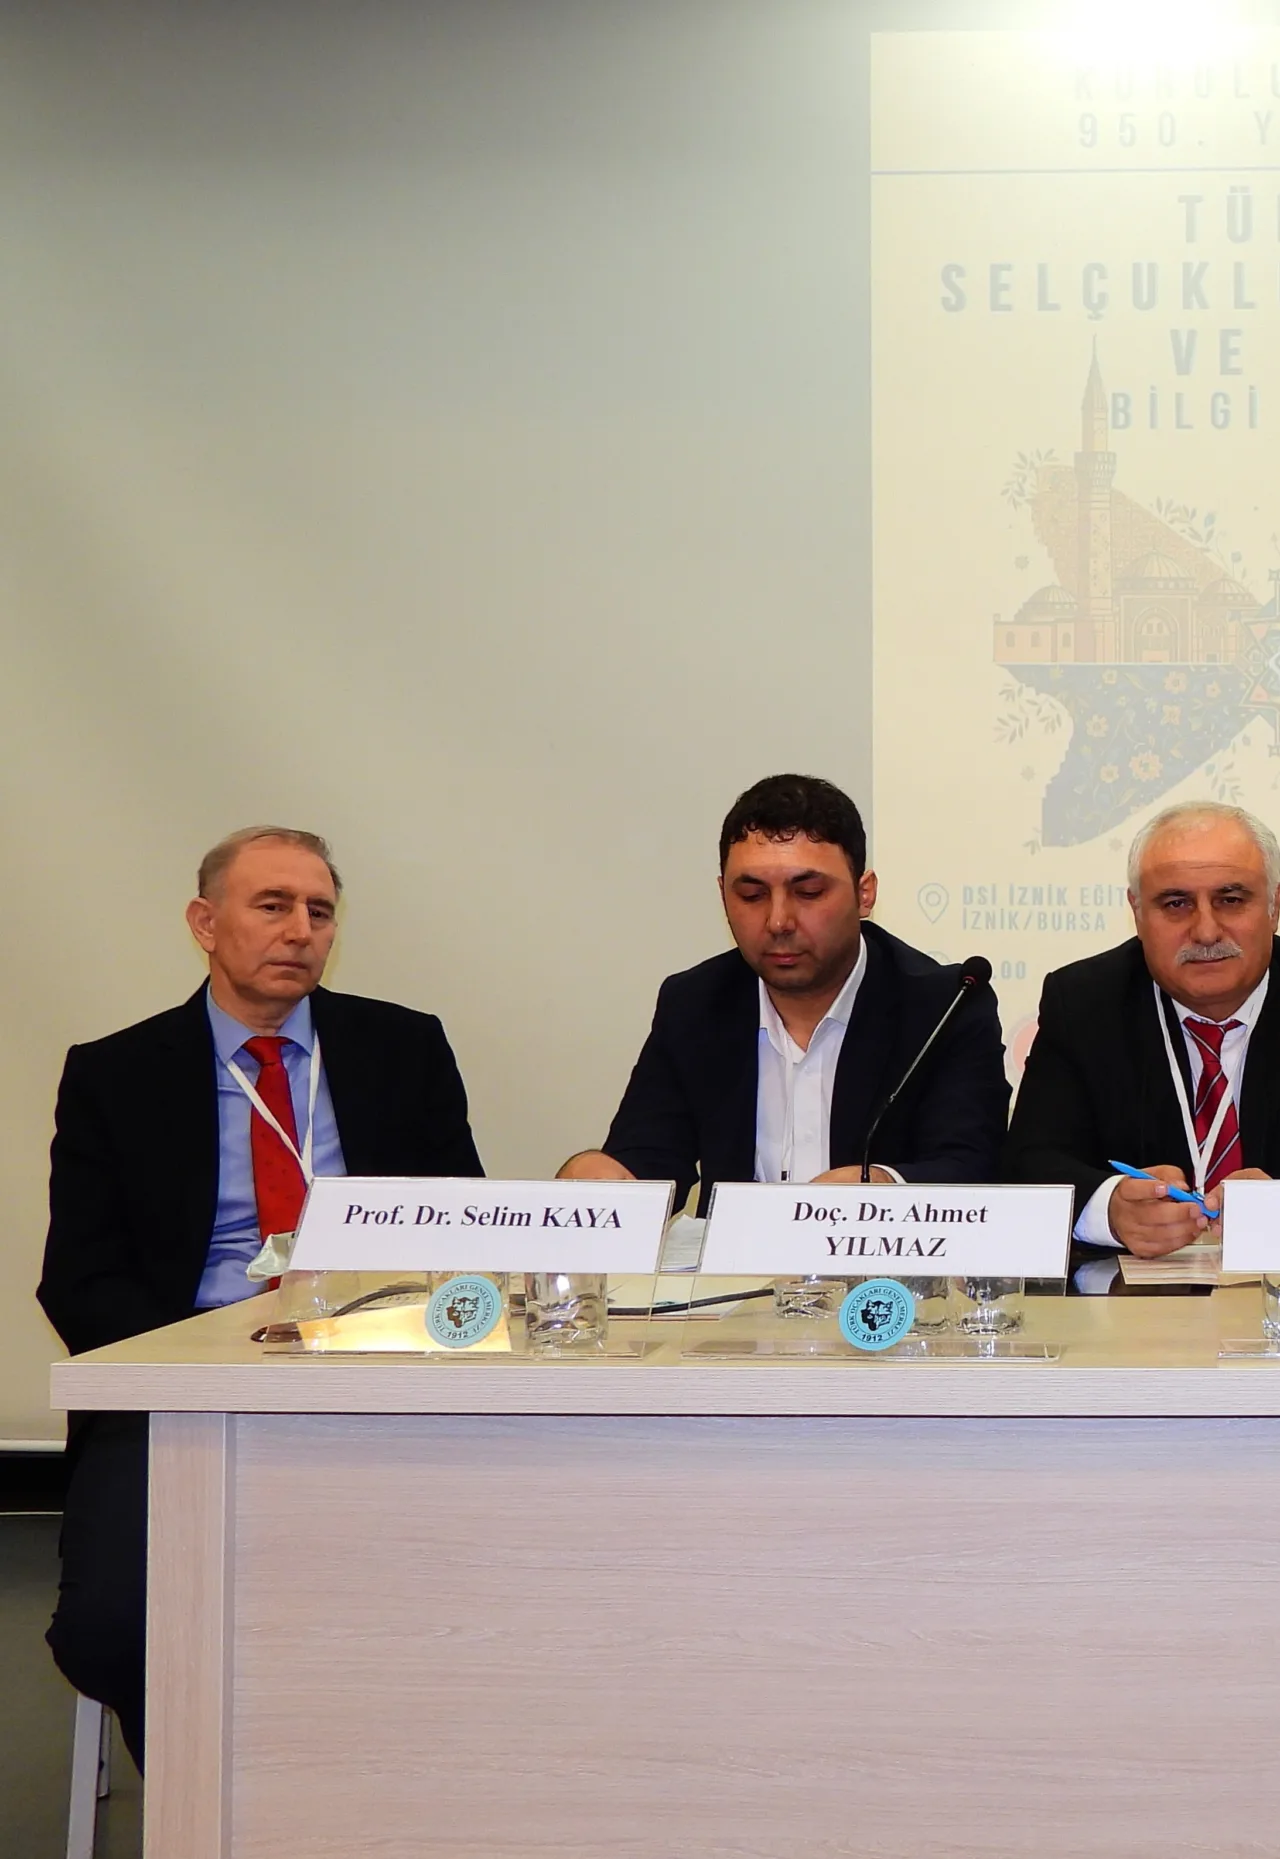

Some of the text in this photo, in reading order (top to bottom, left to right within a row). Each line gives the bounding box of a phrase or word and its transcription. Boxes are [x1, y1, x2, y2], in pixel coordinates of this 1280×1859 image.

[1078, 110, 1204, 147] 950.
[1170, 329, 1243, 376] VE
[1112, 385, 1256, 430] BİLGİ
[963, 884, 996, 905] DSİ
[1009, 884, 1067, 906] İZNİK
[1079, 884, 1125, 906] EĞİT
[963, 908, 1104, 931] İZNİK/BURSA
[343, 1205, 621, 1228] Prof. Dr. Selim KAYA
[793, 1202, 988, 1226] Doç. Dr. Ahmet
[826, 1237, 946, 1256] YILMAZ
[850, 1288, 882, 1314] OCAKLARI
[883, 1288, 902, 1303] GENEL
[447, 1331, 468, 1339] 1912
[849, 1315, 860, 1334] TÜRK
[862, 1334, 883, 1342] 1912
